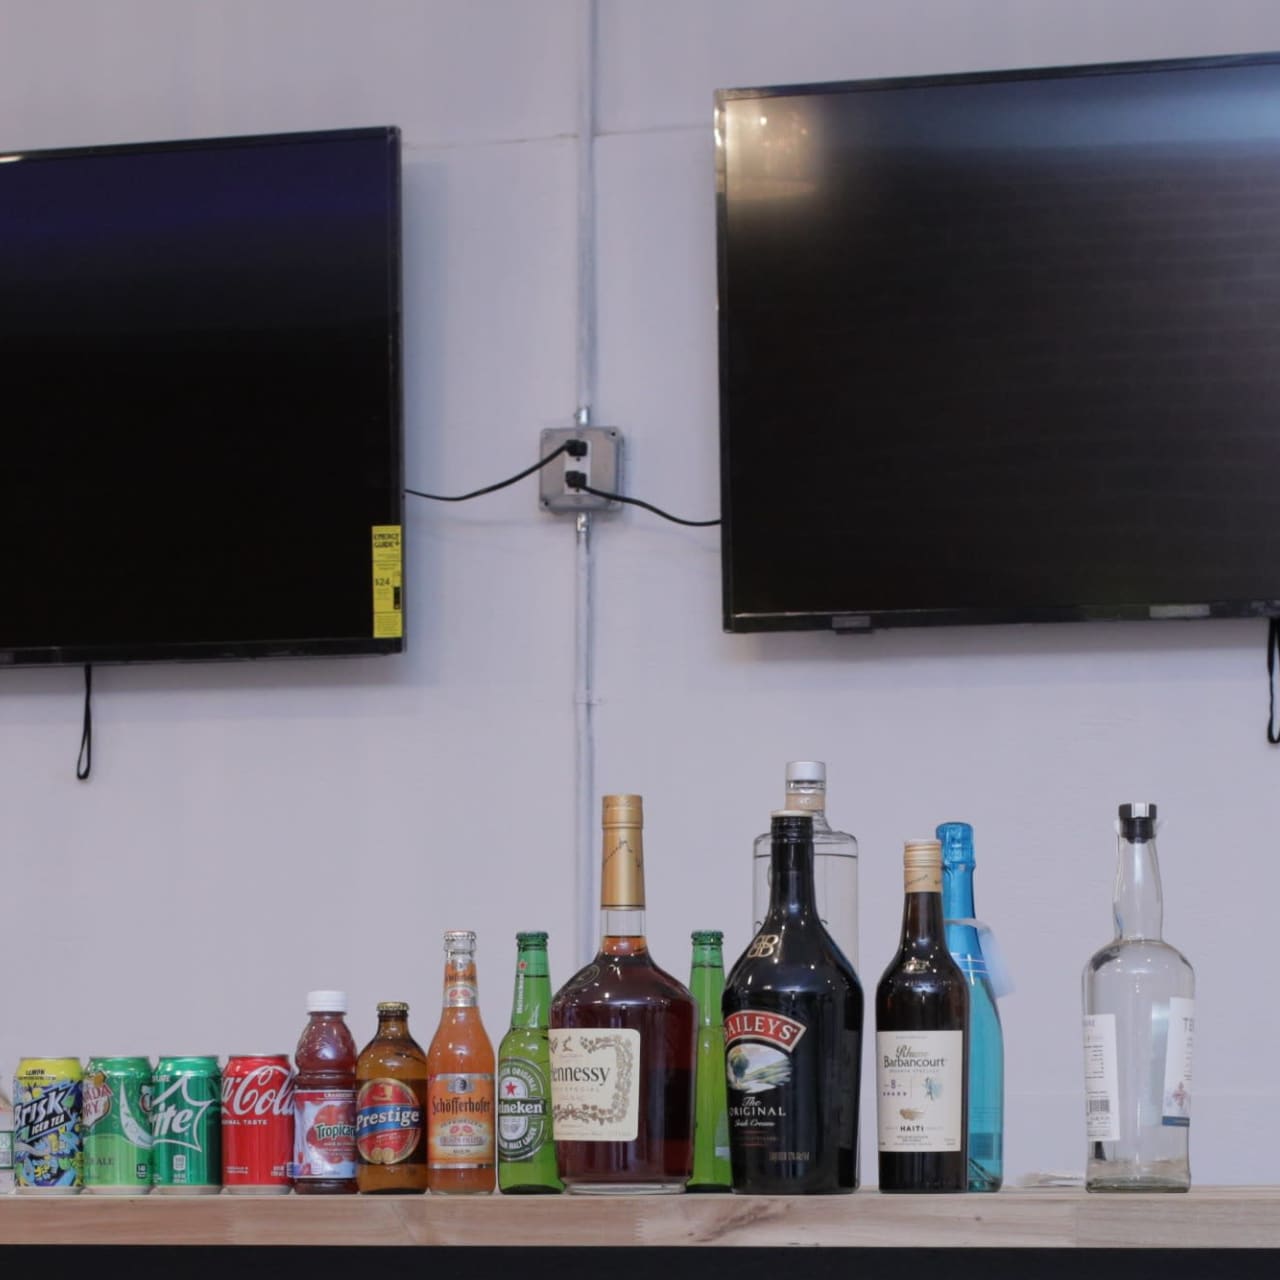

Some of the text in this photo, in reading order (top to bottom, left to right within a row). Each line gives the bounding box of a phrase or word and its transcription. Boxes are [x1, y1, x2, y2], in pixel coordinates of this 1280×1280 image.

[883, 1055, 945, 1069] Barbancourt
[499, 1100, 543, 1114] ineken
[742, 1096, 762, 1107] The
[729, 1106, 787, 1117] ORIGINAL
[31, 1114, 65, 1136] ICED TEA
[356, 1107, 420, 1131] Prestige
[316, 1124, 357, 1139] Tropican
